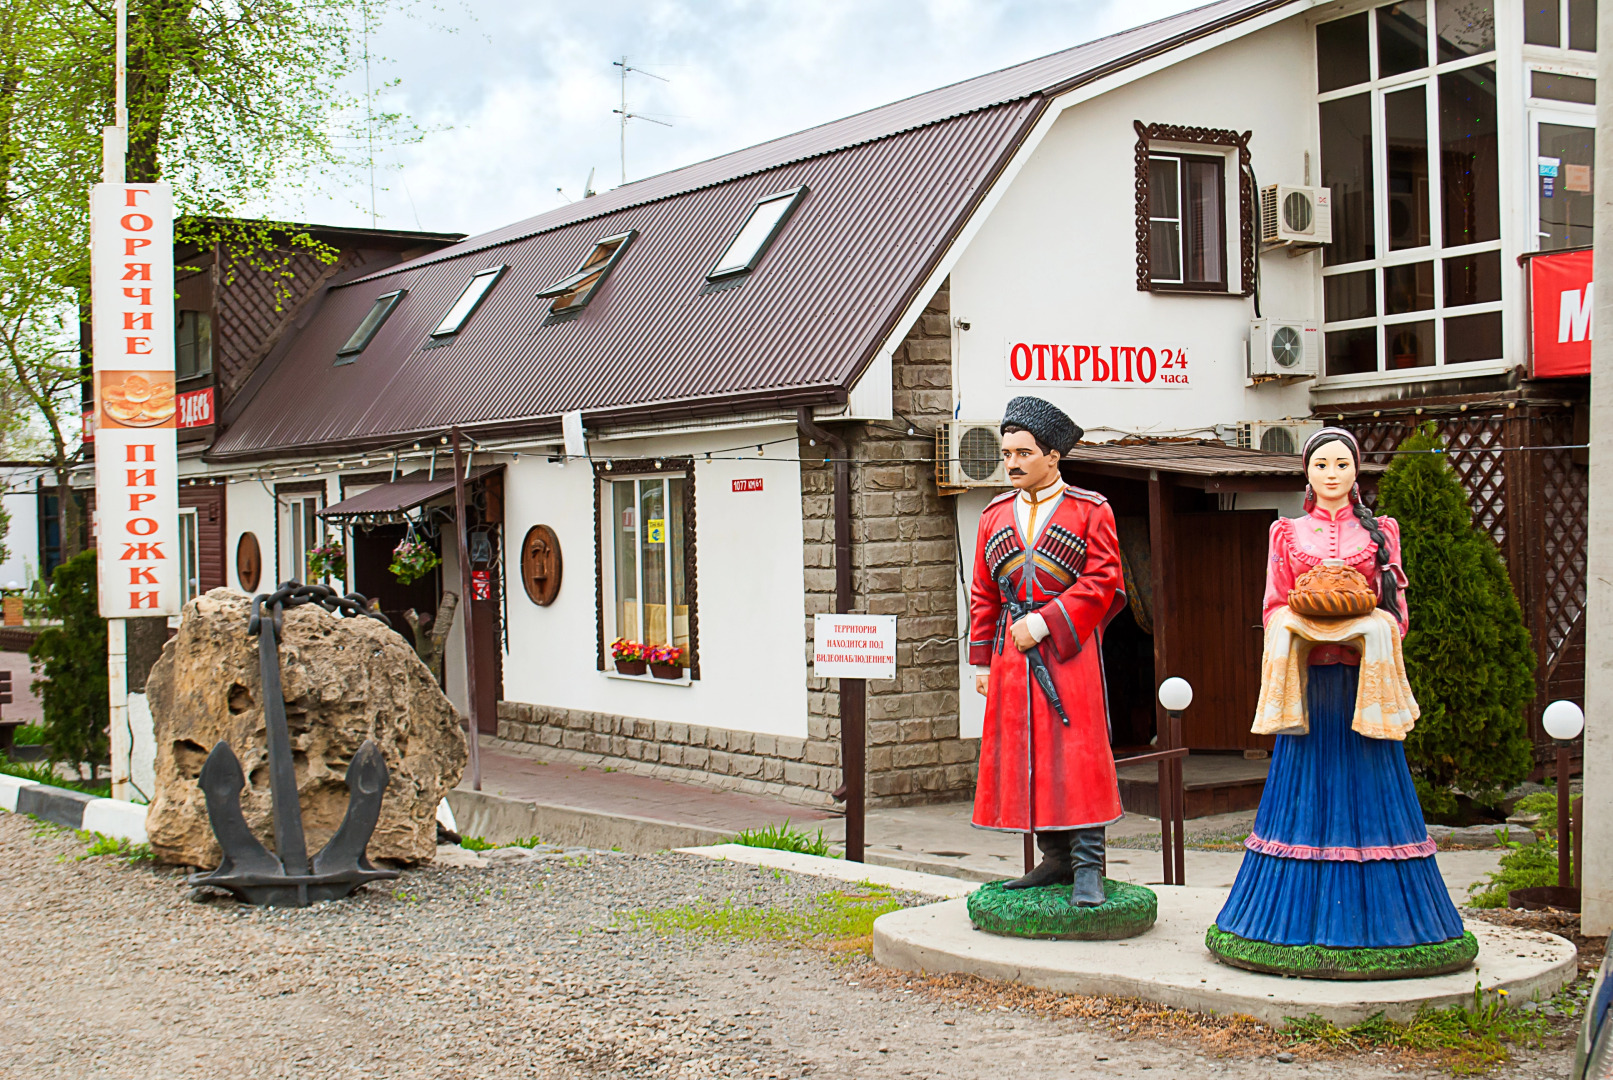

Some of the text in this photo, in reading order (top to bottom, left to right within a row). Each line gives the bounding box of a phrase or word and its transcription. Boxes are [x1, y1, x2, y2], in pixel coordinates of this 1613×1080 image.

[120, 188, 154, 355] ГОРЯЧИЕ
[1010, 342, 1188, 383] ОТКРЫТО 24
[1160, 374, 1188, 384] часа
[179, 393, 210, 427] ЗДЕСЬ
[733, 480, 747, 491] 1077
[119, 444, 168, 609] ПИРОЖКИ
[834, 625, 877, 634] ТЕРРИТОРИЯ
[826, 640, 884, 650] НАХОДИТСЯ ПОД
[816, 654, 894, 664] ВИДЕОНАБЛЮДЕНИЕМ!
